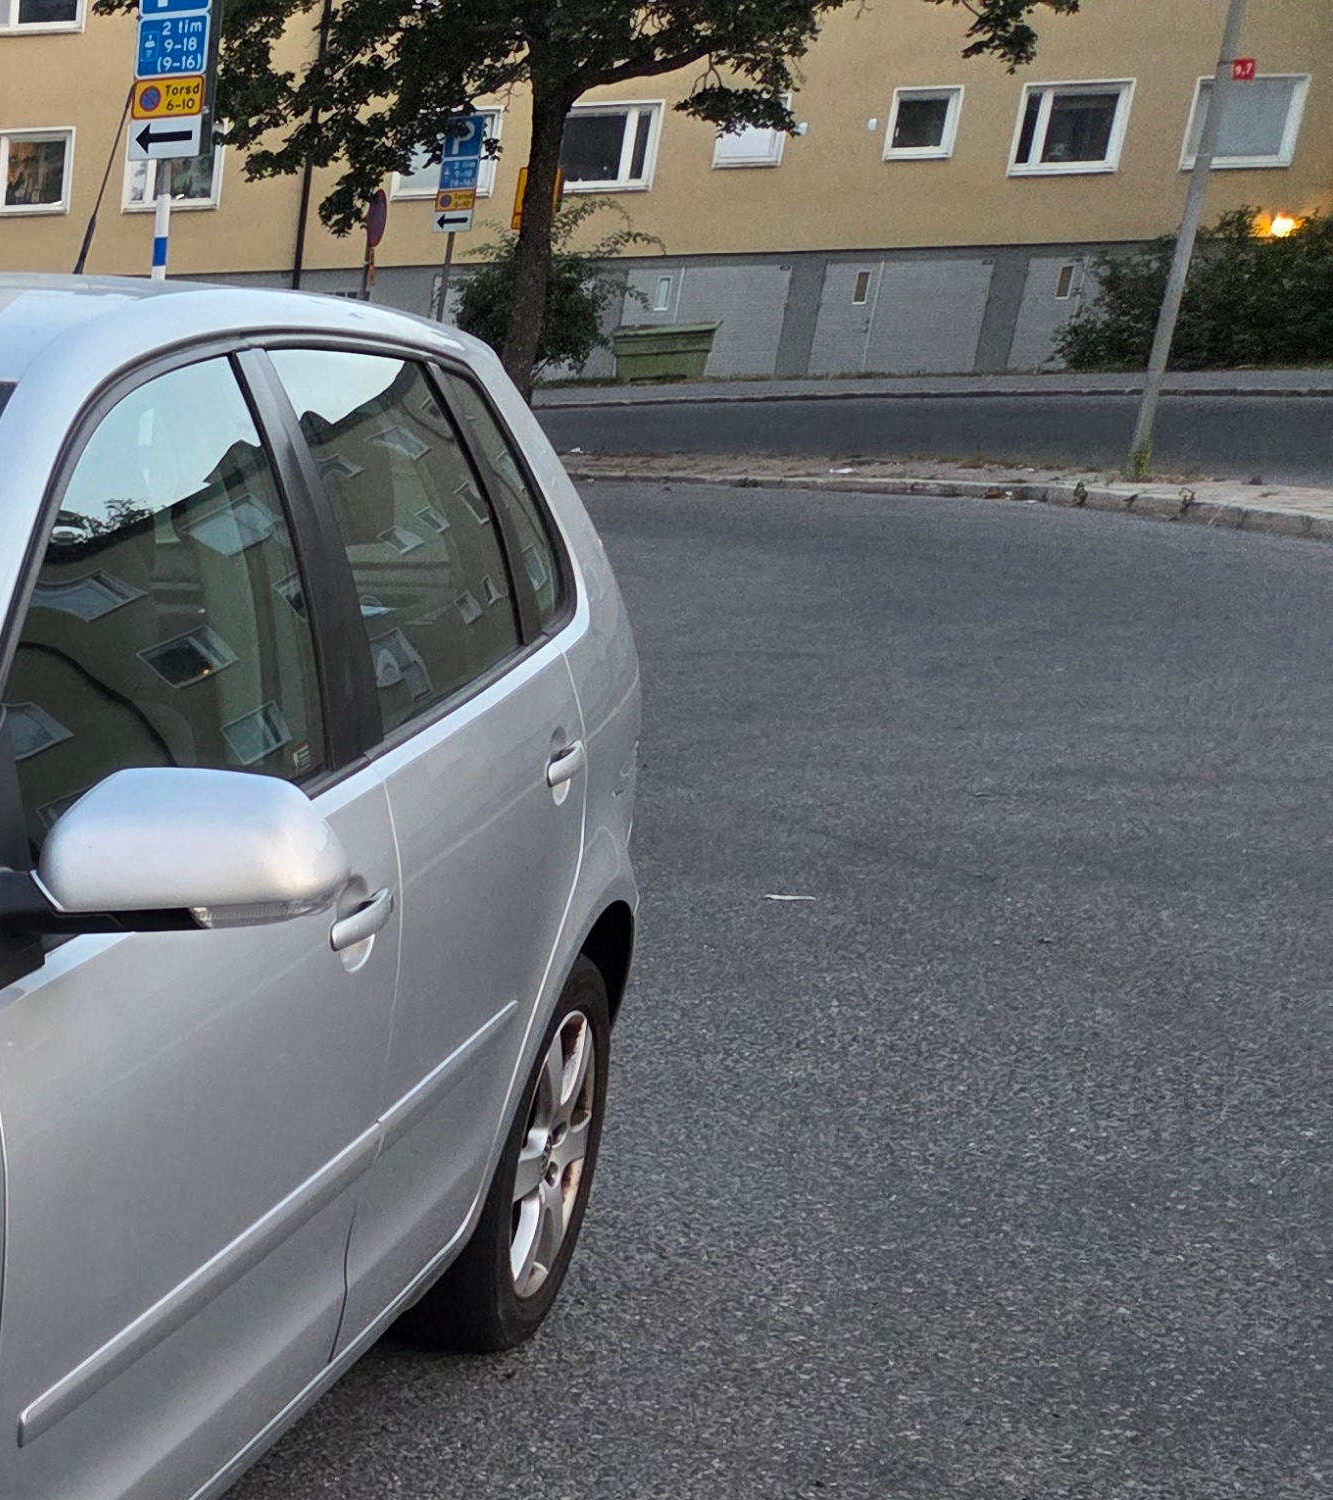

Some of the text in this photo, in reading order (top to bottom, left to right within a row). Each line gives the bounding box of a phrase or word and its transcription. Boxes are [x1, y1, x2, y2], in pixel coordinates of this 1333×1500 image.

[162, 19, 202, 36] 2 tim
[164, 36, 197, 53] 9-18
[157, 53, 201, 73] (9-16)
[165, 82, 200, 97] Torsd
[166, 98, 195, 111] 6-10
